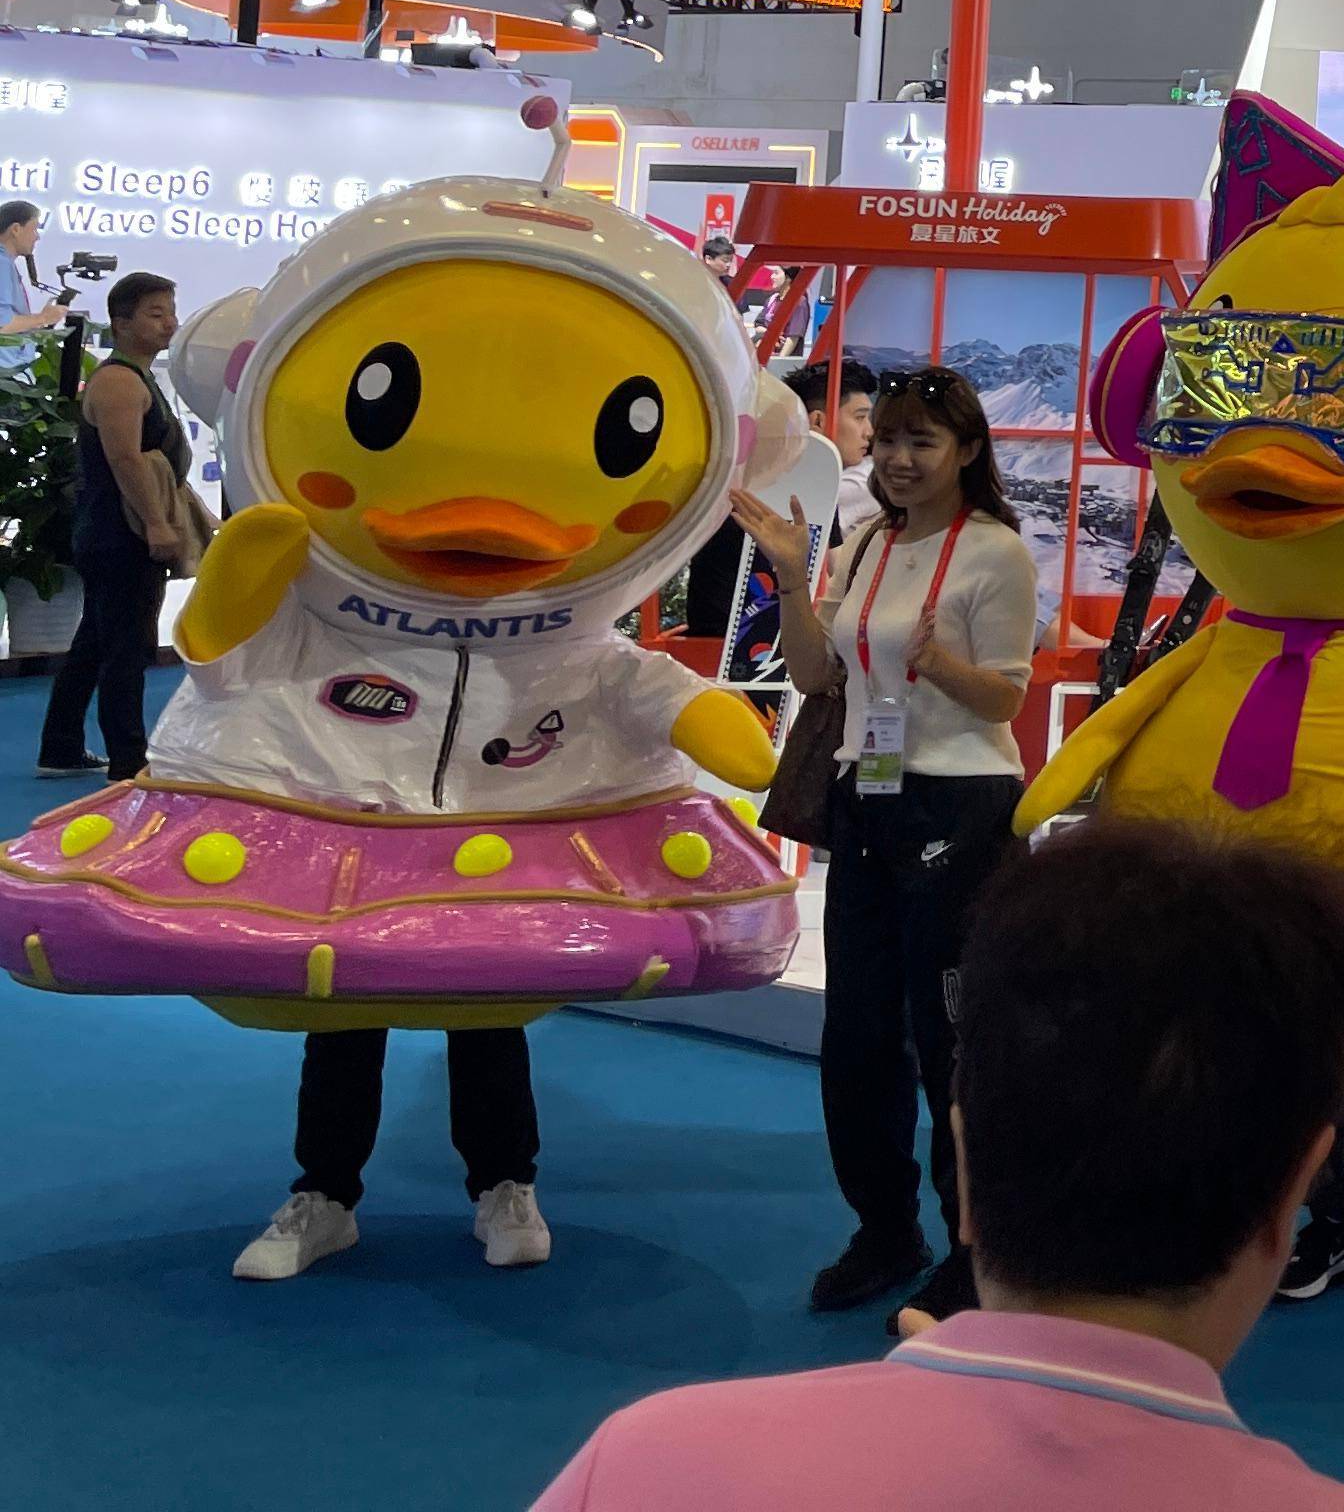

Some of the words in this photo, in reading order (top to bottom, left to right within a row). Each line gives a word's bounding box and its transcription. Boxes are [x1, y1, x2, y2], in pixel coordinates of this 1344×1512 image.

[65, 204, 157, 234] Wave
[170, 208, 264, 245] Sleep
[859, 195, 957, 220] FOSUN
[962, 196, 1061, 236] Holiday
[909, 223, 1002, 245] 复星旅文
[337, 593, 573, 639] ATLANTIS
